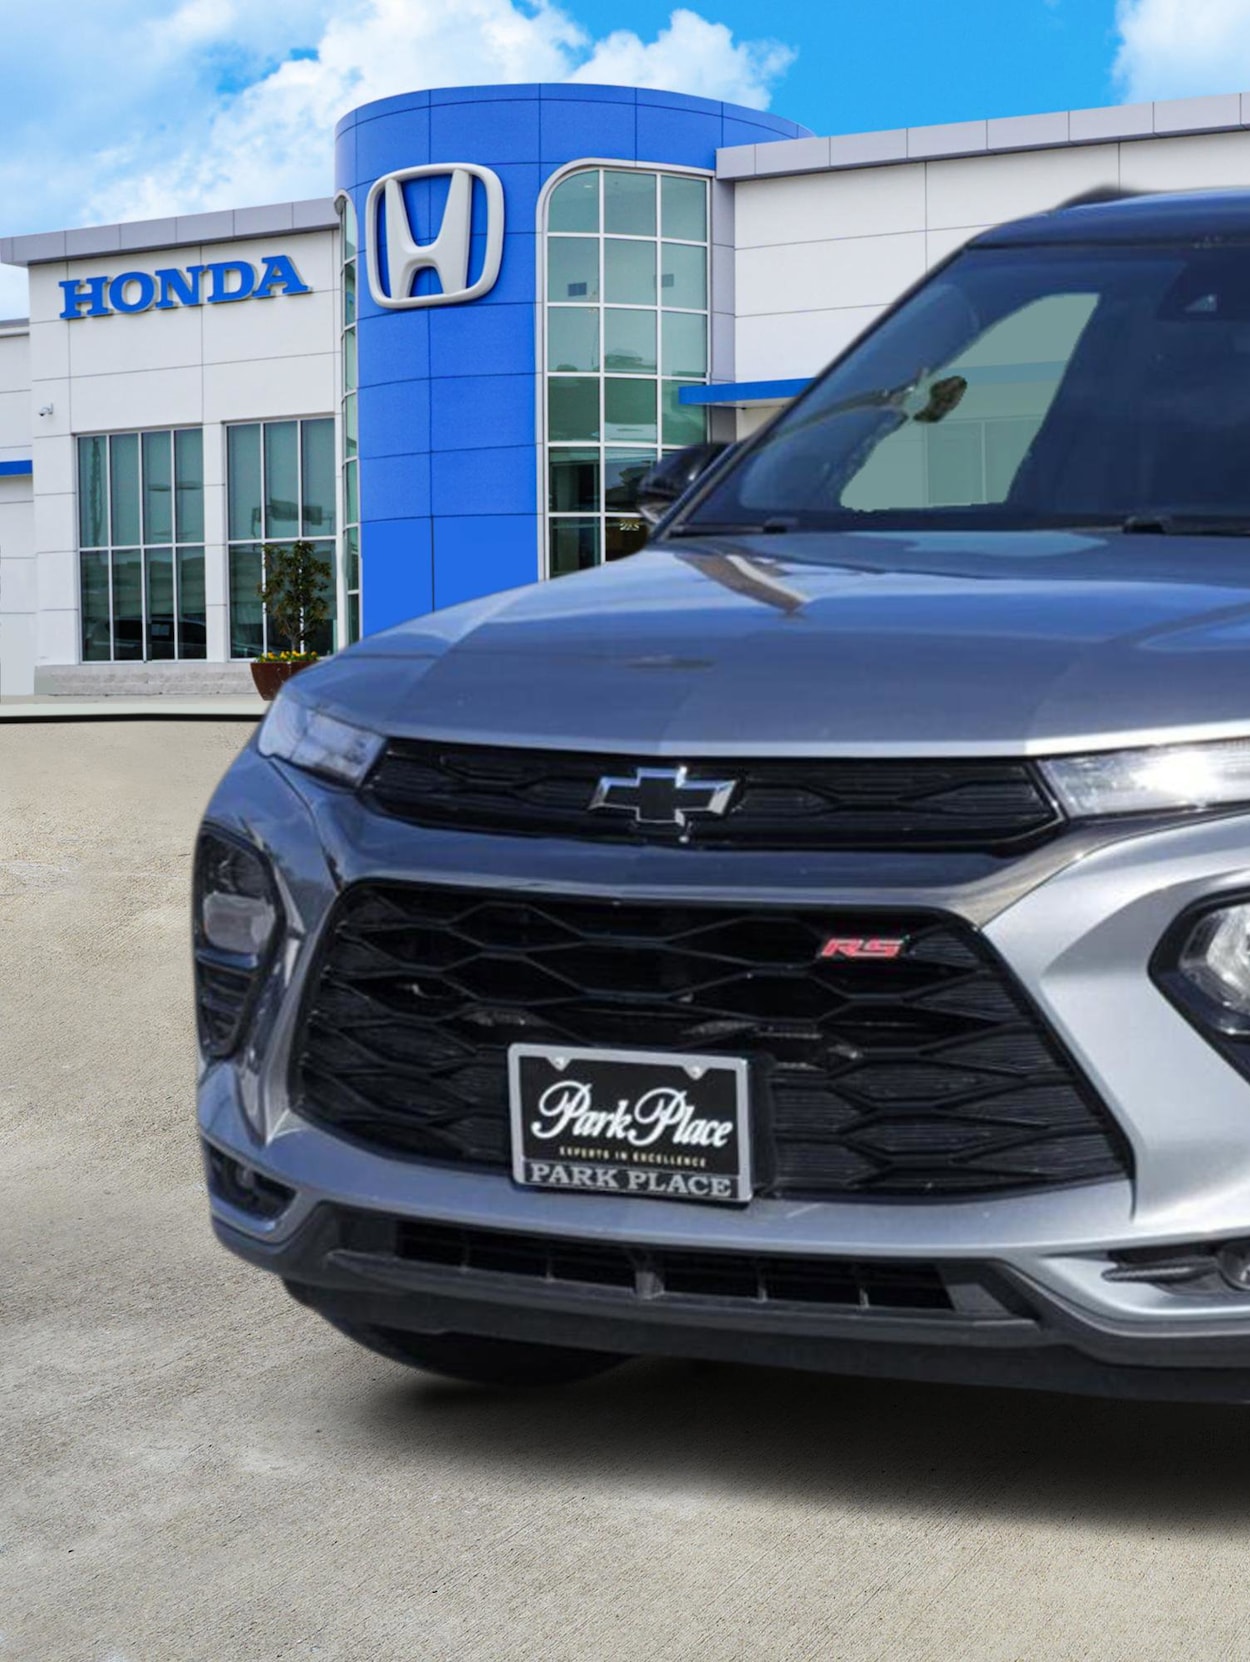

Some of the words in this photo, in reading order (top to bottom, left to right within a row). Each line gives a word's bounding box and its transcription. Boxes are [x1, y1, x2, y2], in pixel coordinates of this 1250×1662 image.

[58, 254, 311, 320] HONDA
[820, 938, 904, 957] RS
[530, 1080, 630, 1139] Park
[627, 1086, 734, 1148] Place
[530, 1162, 619, 1189] PARK
[627, 1170, 732, 1198] PLACE
